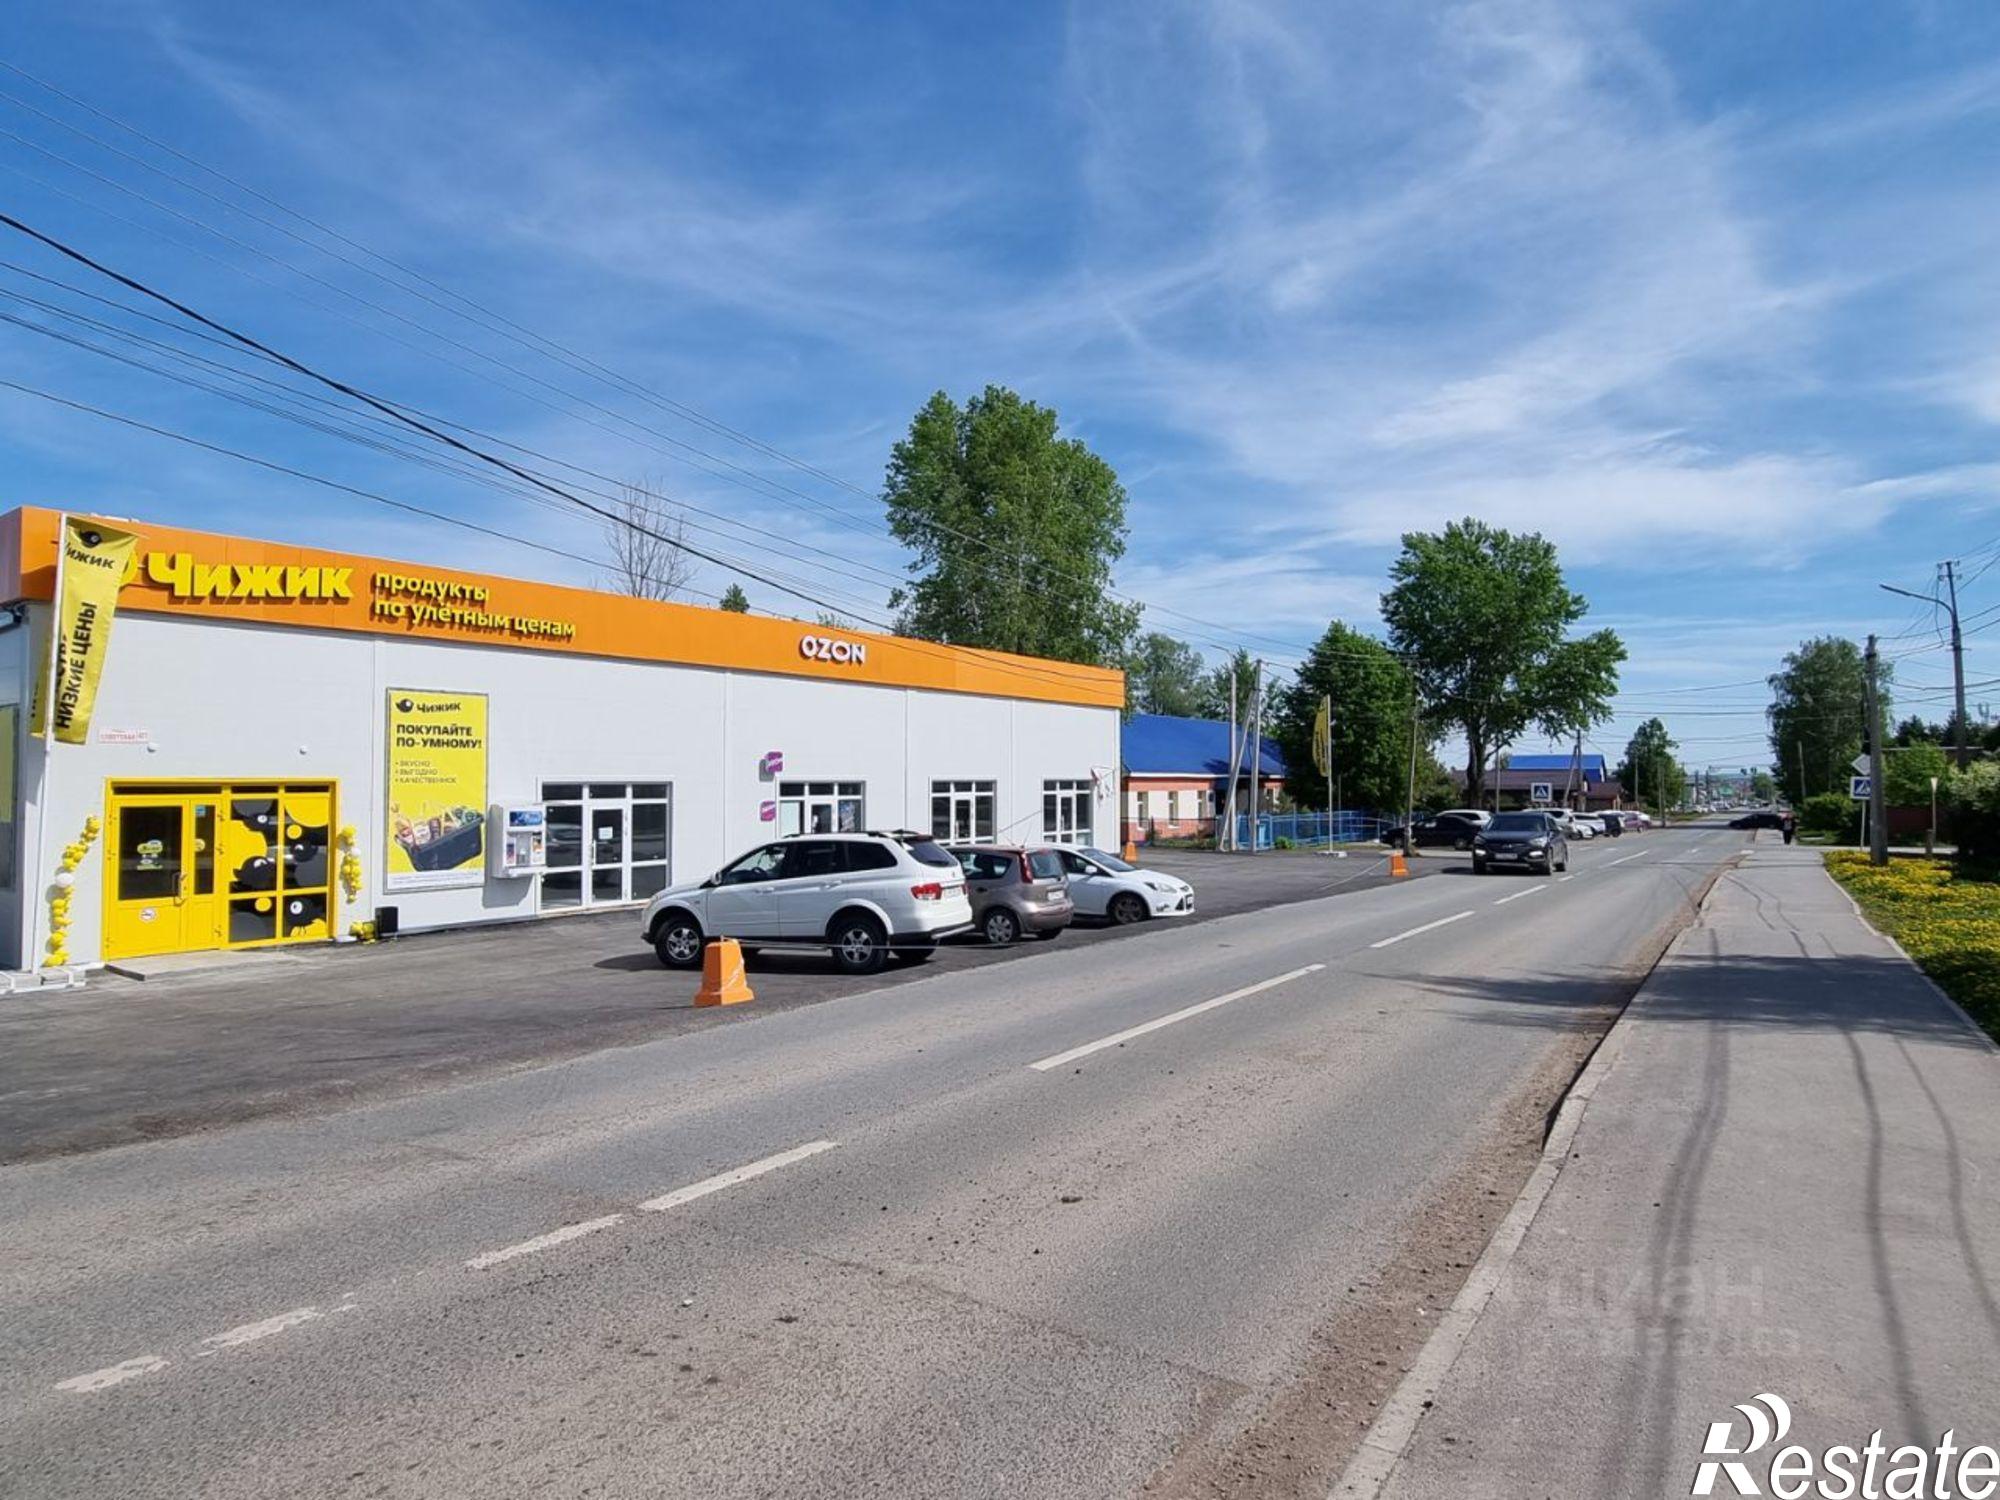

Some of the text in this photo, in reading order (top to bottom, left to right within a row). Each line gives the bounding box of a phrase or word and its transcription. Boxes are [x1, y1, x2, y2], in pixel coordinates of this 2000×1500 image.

[148, 552, 354, 597] Чижик
[375, 572, 490, 602] продукты
[374, 600, 577, 636] по улётным ценам
[801, 635, 866, 663] OZON
[56, 658, 85, 729] НИЗКИЕ
[71, 602, 97, 656] ЦЕНЫ
[396, 723, 472, 737] ПОКУПАЙТЕ
[396, 737, 483, 749] ПО-УМНОМУ!
